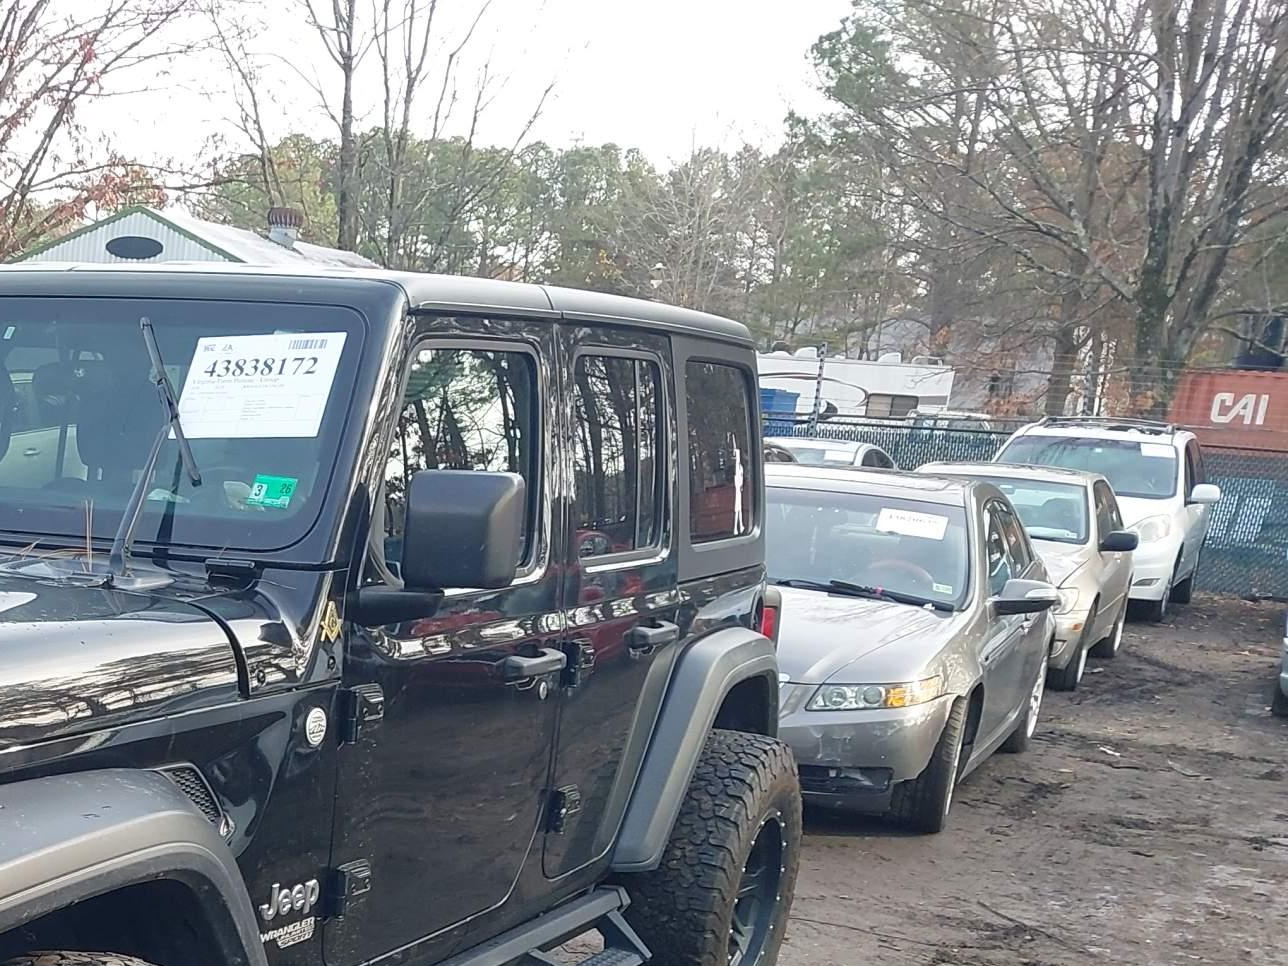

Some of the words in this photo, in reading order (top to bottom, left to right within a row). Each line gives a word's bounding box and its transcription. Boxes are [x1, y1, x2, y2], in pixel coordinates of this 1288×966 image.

[204, 356, 319, 377] 43838172
[1210, 392, 1270, 425] CAI
[254, 484, 263, 497] 3
[280, 483, 292, 494] 26
[259, 879, 320, 921] Jeep
[260, 916, 316, 943] WRANGLER
